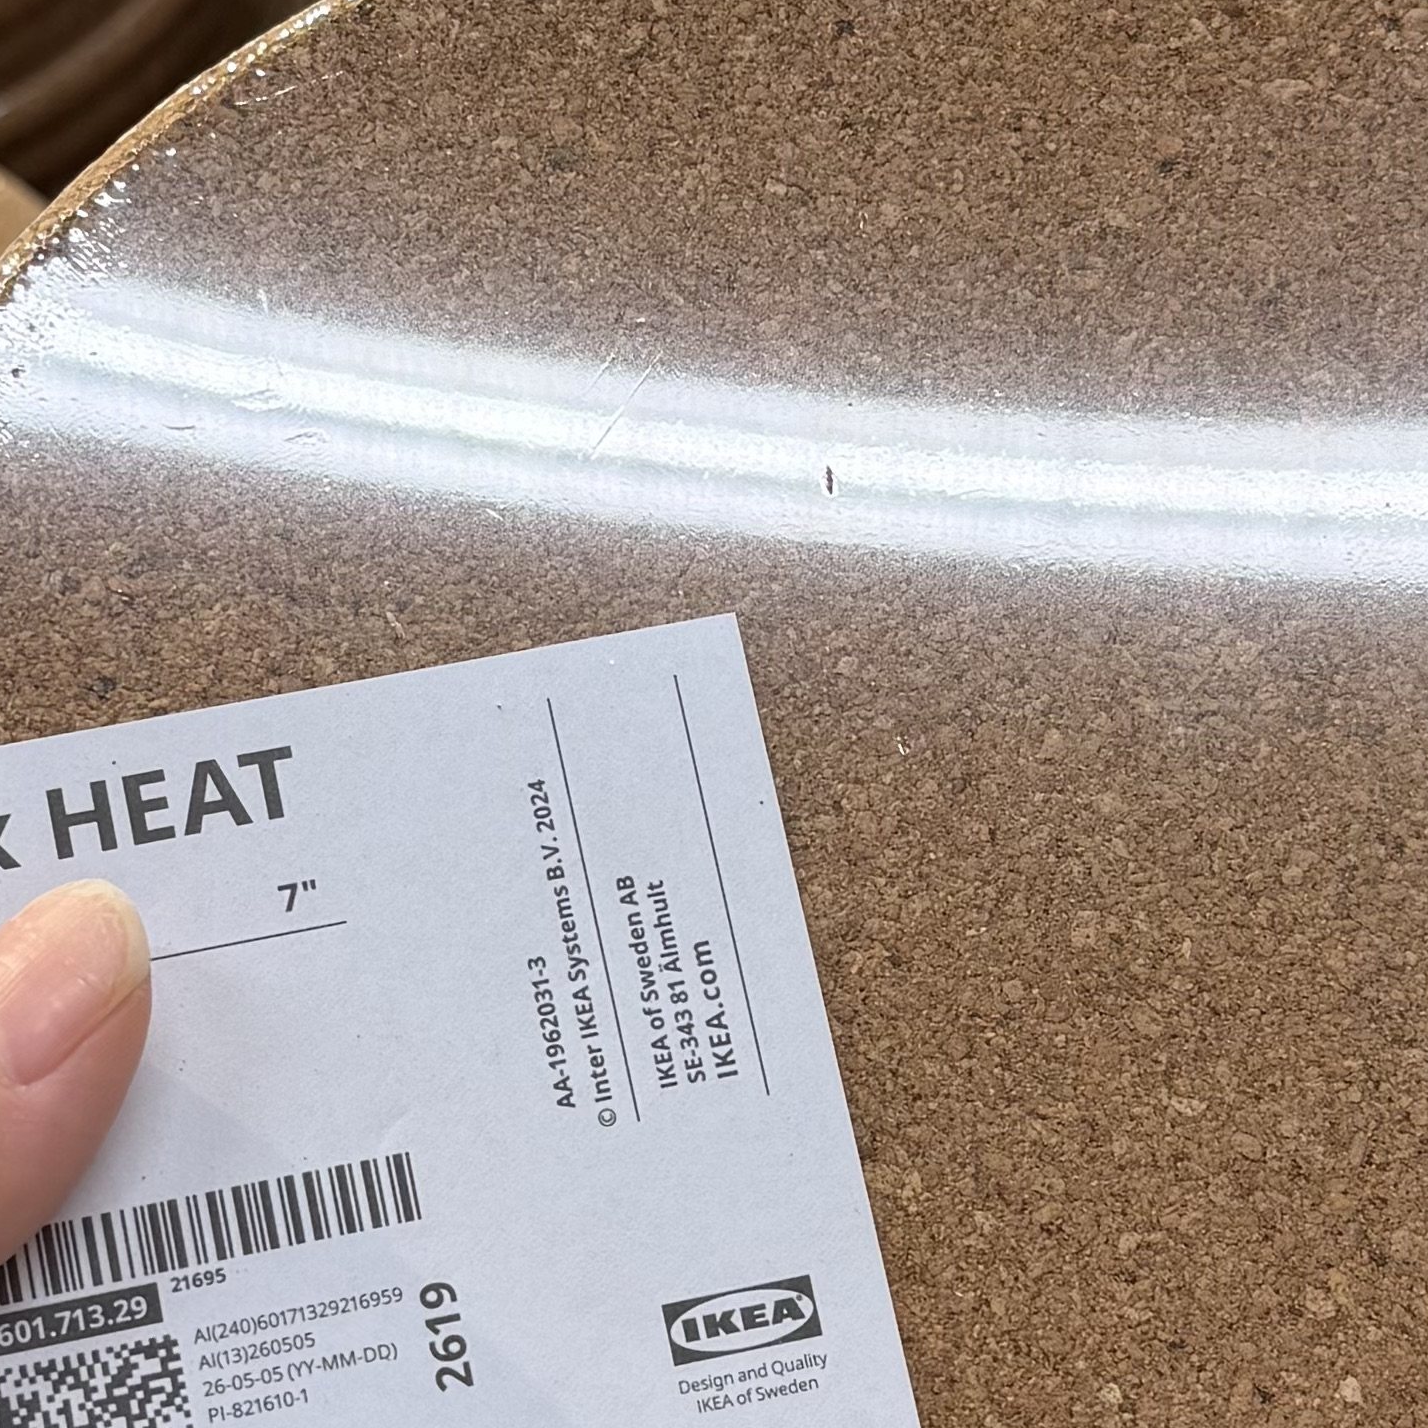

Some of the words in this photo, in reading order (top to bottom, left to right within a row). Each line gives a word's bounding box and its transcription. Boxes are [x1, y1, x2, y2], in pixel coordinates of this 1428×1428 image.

[47, 746, 290, 858] HEAT
[526, 778, 555, 833] 2024
[539, 836, 565, 881] B.V.
[276, 878, 316, 913] 7"
[615, 874, 639, 906] AB
[553, 884, 589, 982] Systems
[646, 879, 682, 972] Älmhult
[627, 911, 659, 1002] Sweden
[571, 984, 599, 1039] IKEA
[641, 1006, 665, 1030] of
[666, 979, 689, 1004] 81
[693, 940, 738, 1078] IKEA.com
[527, 956, 575, 1108] AA-1962031-3
[673, 1008, 706, 1083] SE-343
[586, 1044, 612, 1103] Inter
[650, 1033, 678, 1089] IKEA
[169, 1266, 226, 1293] 21695
[194, 1286, 403, 1343] AI(240)60171329216959
[419, 1281, 473, 1391] 2619
[681, 1295, 804, 1342] IKEA
[198, 1331, 315, 1370] AI(13)260505
[202, 1365, 284, 1397] 26-05-05
[286, 1342, 398, 1381] (YY-MM-DD)
[677, 1373, 734, 1395] Design
[737, 1361, 768, 1383] and
[770, 1352, 827, 1376] Quality
[207, 1387, 308, 1423] PI-821610-1
[695, 1393, 734, 1413] IKEA
[735, 1386, 752, 1406] of
[754, 1377, 819, 1402] Sweden
